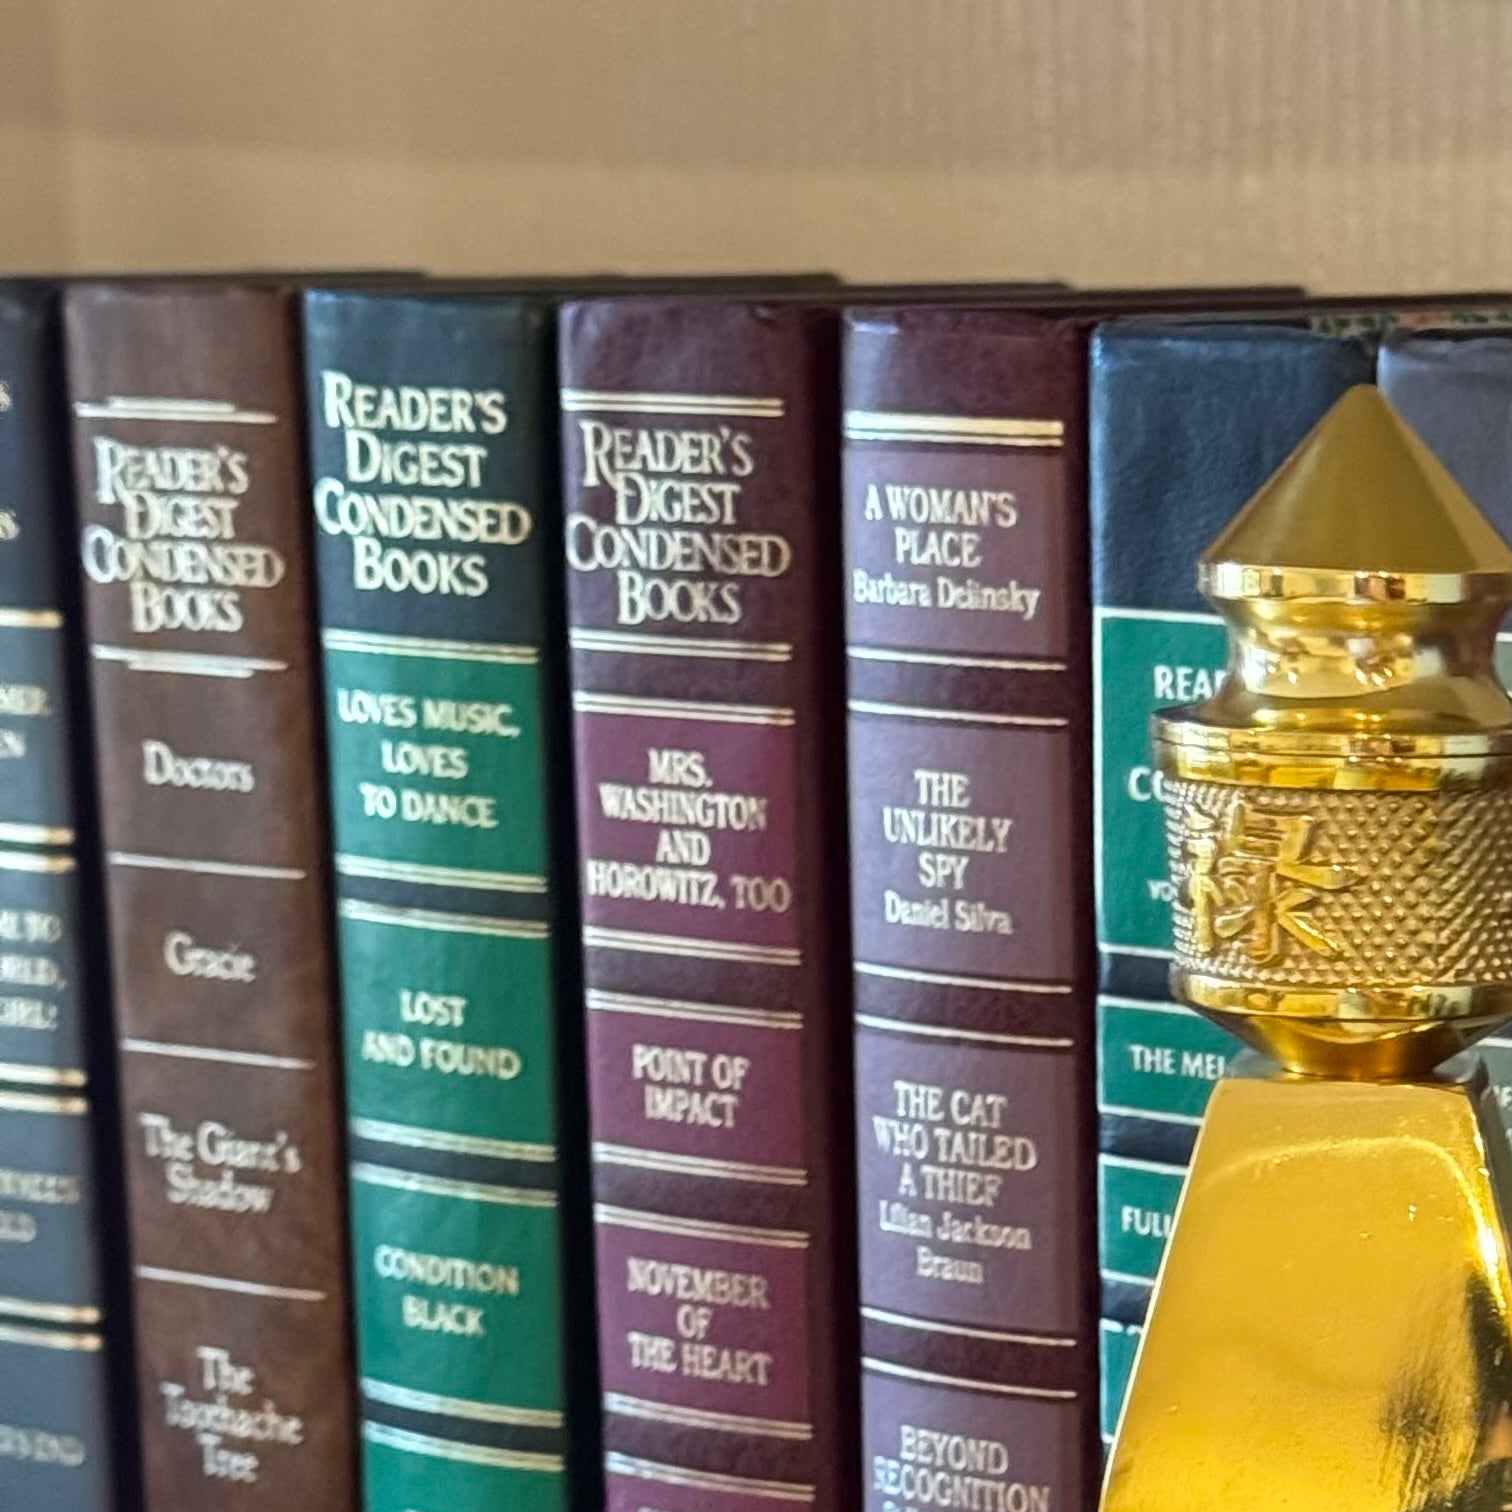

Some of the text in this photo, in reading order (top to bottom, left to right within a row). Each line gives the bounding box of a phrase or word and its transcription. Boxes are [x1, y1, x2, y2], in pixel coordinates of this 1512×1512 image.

[321, 370, 508, 434] READER'S
[94, 436, 249, 504] READER'S
[346, 430, 488, 488] DIGEST
[580, 420, 755, 488] READER'S
[123, 493, 239, 540] DIGEST
[315, 477, 534, 546] CONDENSED
[615, 471, 742, 526] DIGEST
[864, 484, 1018, 529] A WOMAN'S
[82, 525, 286, 588] CONDENSED
[354, 536, 489, 598] BOOKS
[566, 512, 792, 579] CONDENSED
[895, 526, 984, 569] PLACE
[131, 582, 243, 633] BOOKS
[616, 568, 743, 626] BOOKS
[853, 568, 1041, 620] Barbara Delinsky
[337, 688, 417, 729] LOVES
[381, 742, 469, 779] LOVES
[647, 747, 714, 790] MRS.
[358, 784, 498, 830] TO DANCE
[598, 783, 768, 833] WASHINGTON
[915, 770, 970, 808] THE
[655, 828, 712, 866] AND
[883, 807, 1013, 854] UNLIKELY
[586, 861, 792, 914] HOROWITZ, TOO
[918, 854, 969, 891] SPY
[883, 891, 1014, 936] Daniel Silva
[401, 990, 468, 1029] LOST
[362, 1031, 522, 1082] AND FOUND
[631, 1044, 750, 1089] POINT OF
[1129, 1044, 1176, 1076] THE
[644, 1086, 740, 1129] IMPACT
[892, 1080, 1008, 1130] THE CAT
[872, 1116, 1038, 1172] WHO TAILED
[898, 1162, 1003, 1207] A THIEF
[936, 1210, 1031, 1251] Jackson
[373, 1243, 520, 1297] CONDITION
[627, 1256, 770, 1310] NOVEMBER
[915, 1246, 984, 1285] Braun
[402, 1297, 486, 1339] BLACK
[675, 1304, 713, 1340] OF
[627, 1332, 774, 1387] THE HEART
[899, 1424, 1009, 1475] BEYOND
